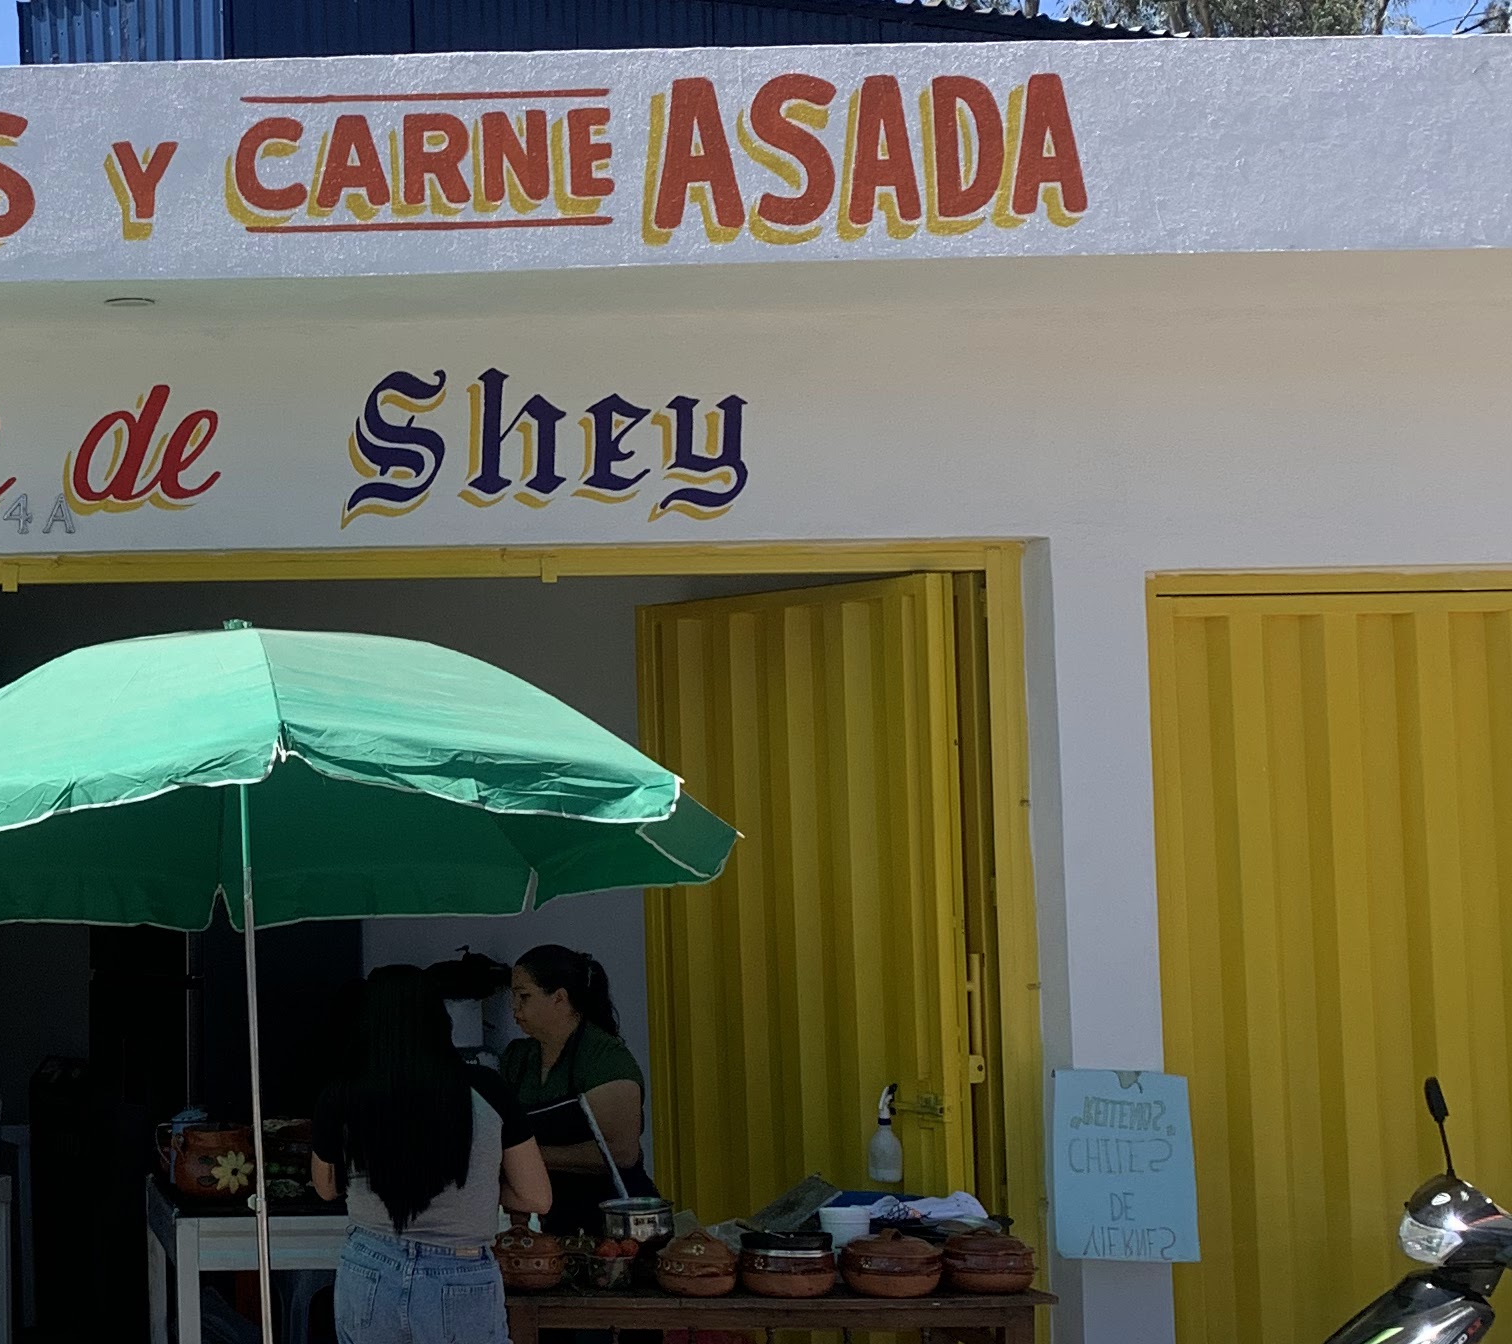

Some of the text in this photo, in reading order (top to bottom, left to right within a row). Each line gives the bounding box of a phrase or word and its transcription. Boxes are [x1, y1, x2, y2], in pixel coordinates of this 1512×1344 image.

[105, 140, 178, 241] Y
[225, 106, 615, 226] CARNE
[643, 72, 1088, 245] ASADA
[64, 383, 220, 514] de
[340, 367, 750, 529] Shey
